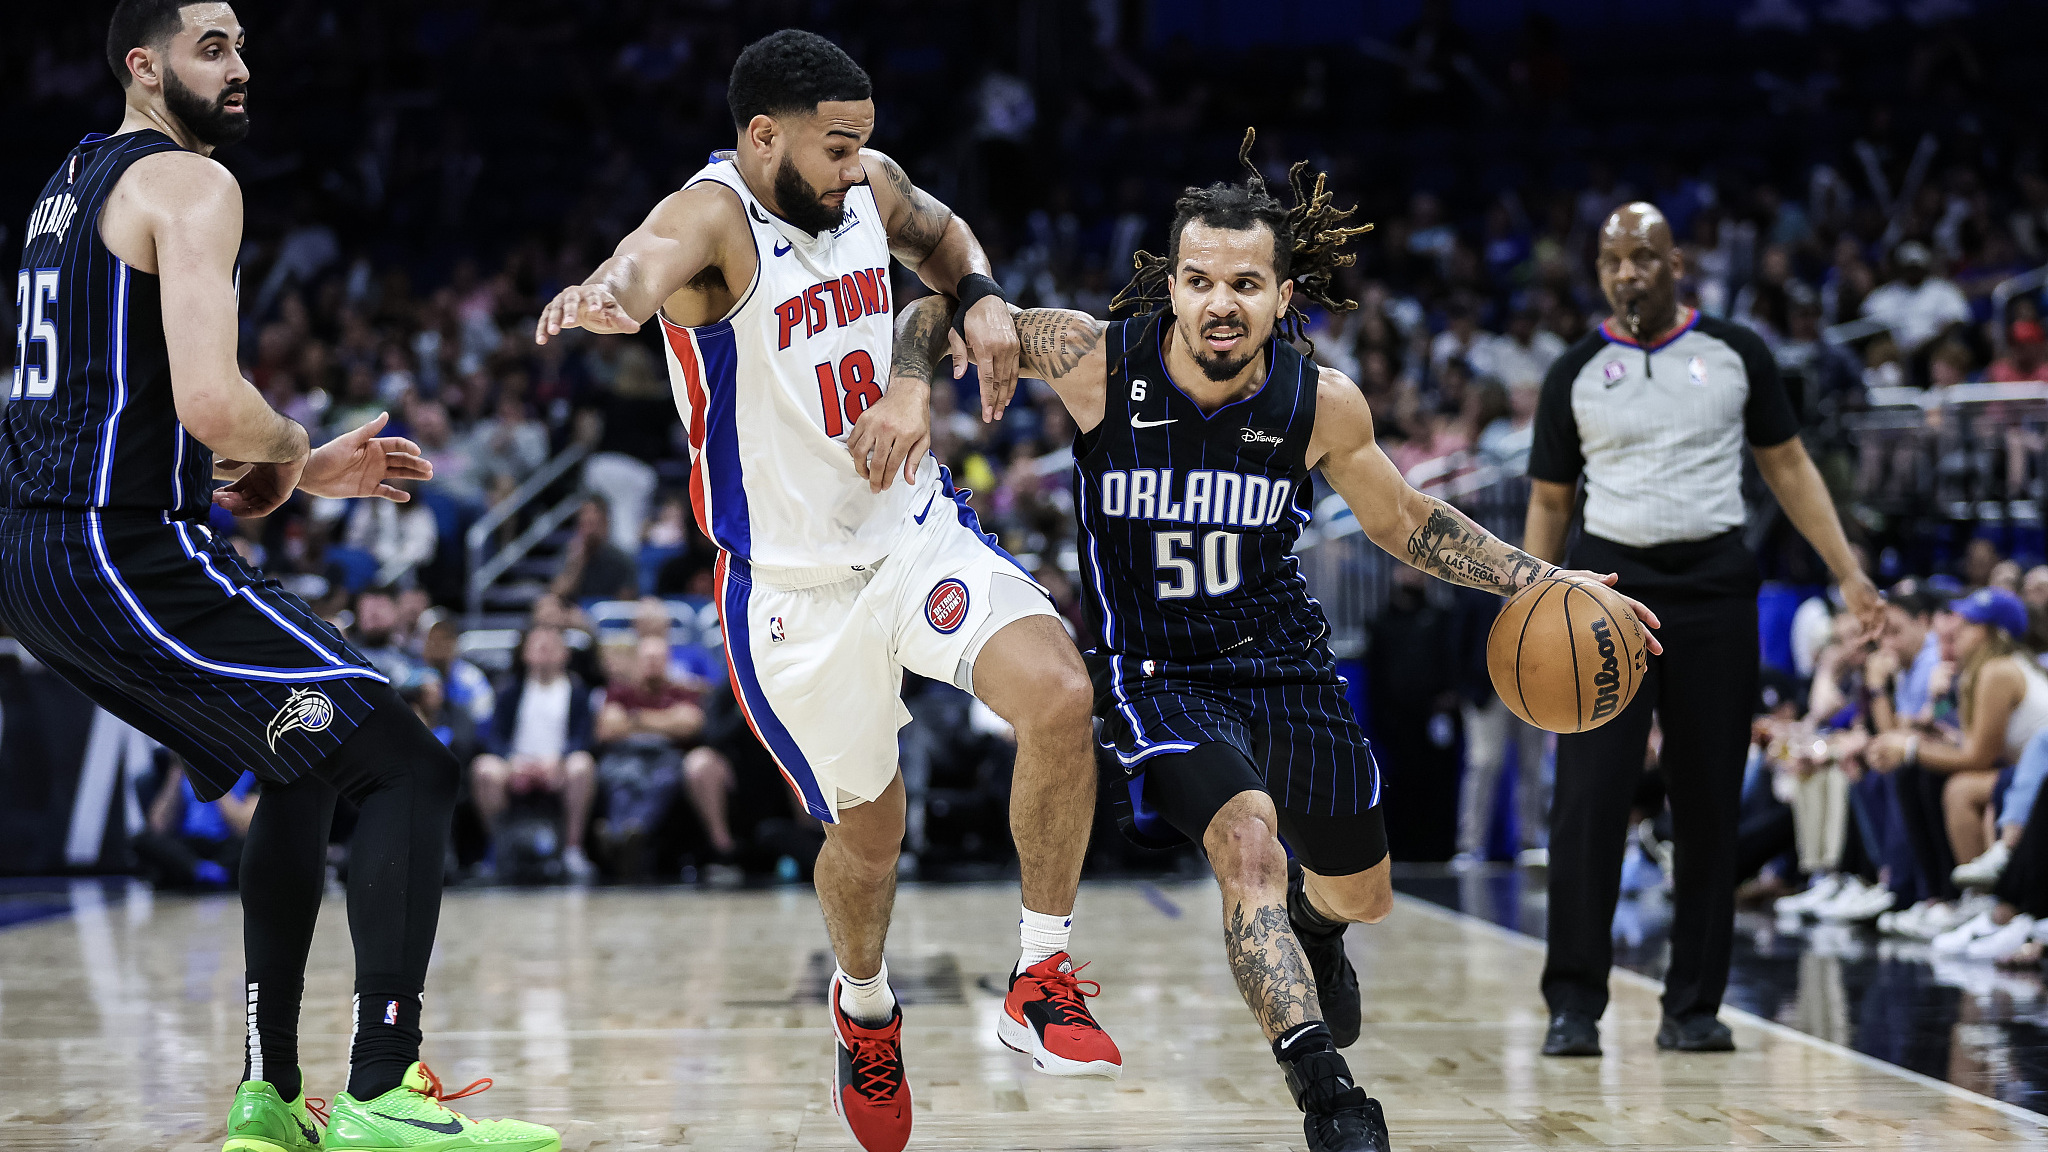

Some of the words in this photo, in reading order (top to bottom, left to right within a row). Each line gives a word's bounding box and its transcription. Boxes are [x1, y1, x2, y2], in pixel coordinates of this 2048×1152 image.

[9, 267, 61, 400] 35
[774, 268, 889, 351] PISTONS
[815, 349, 884, 438] 18
[1130, 379, 1147, 402] 6
[1101, 468, 1292, 527] ORLANDO
[1407, 508, 1445, 558] Tyson
[1155, 530, 1243, 601] 50
[1445, 554, 1465, 571] LAS
[1467, 563, 1501, 585] VEGAS
[932, 587, 959, 617] DETROIT
[936, 594, 962, 624] PISTONS
[1589, 616, 1621, 721] Wilson
